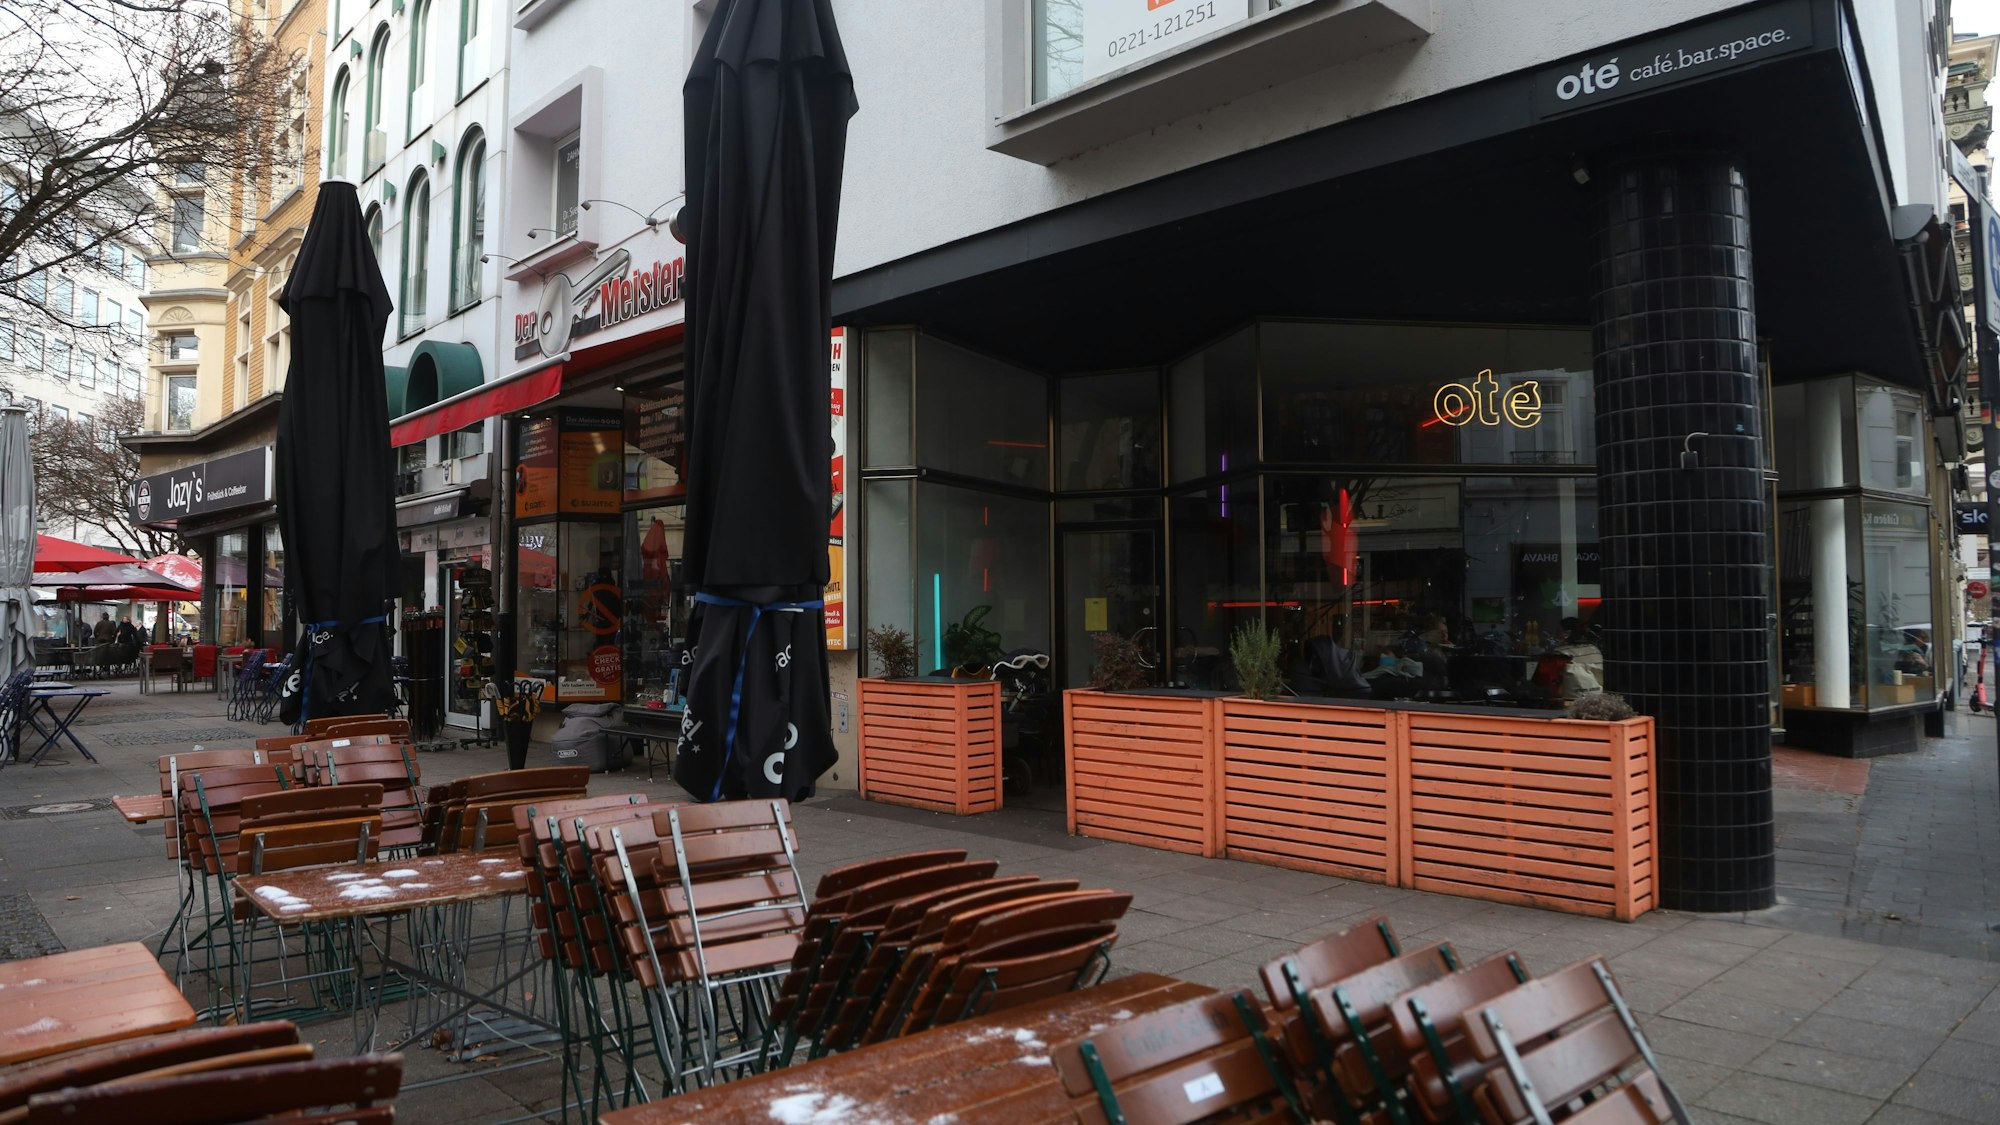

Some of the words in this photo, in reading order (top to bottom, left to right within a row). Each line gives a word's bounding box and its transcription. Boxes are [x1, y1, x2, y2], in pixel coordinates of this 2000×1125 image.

[1108, 1, 1216, 58] 0221-121251
[1556, 57, 1621, 101] oté
[1629, 28, 1791, 82] café.bar.space.
[516, 311, 537, 342] Der
[600, 255, 685, 328] Meister
